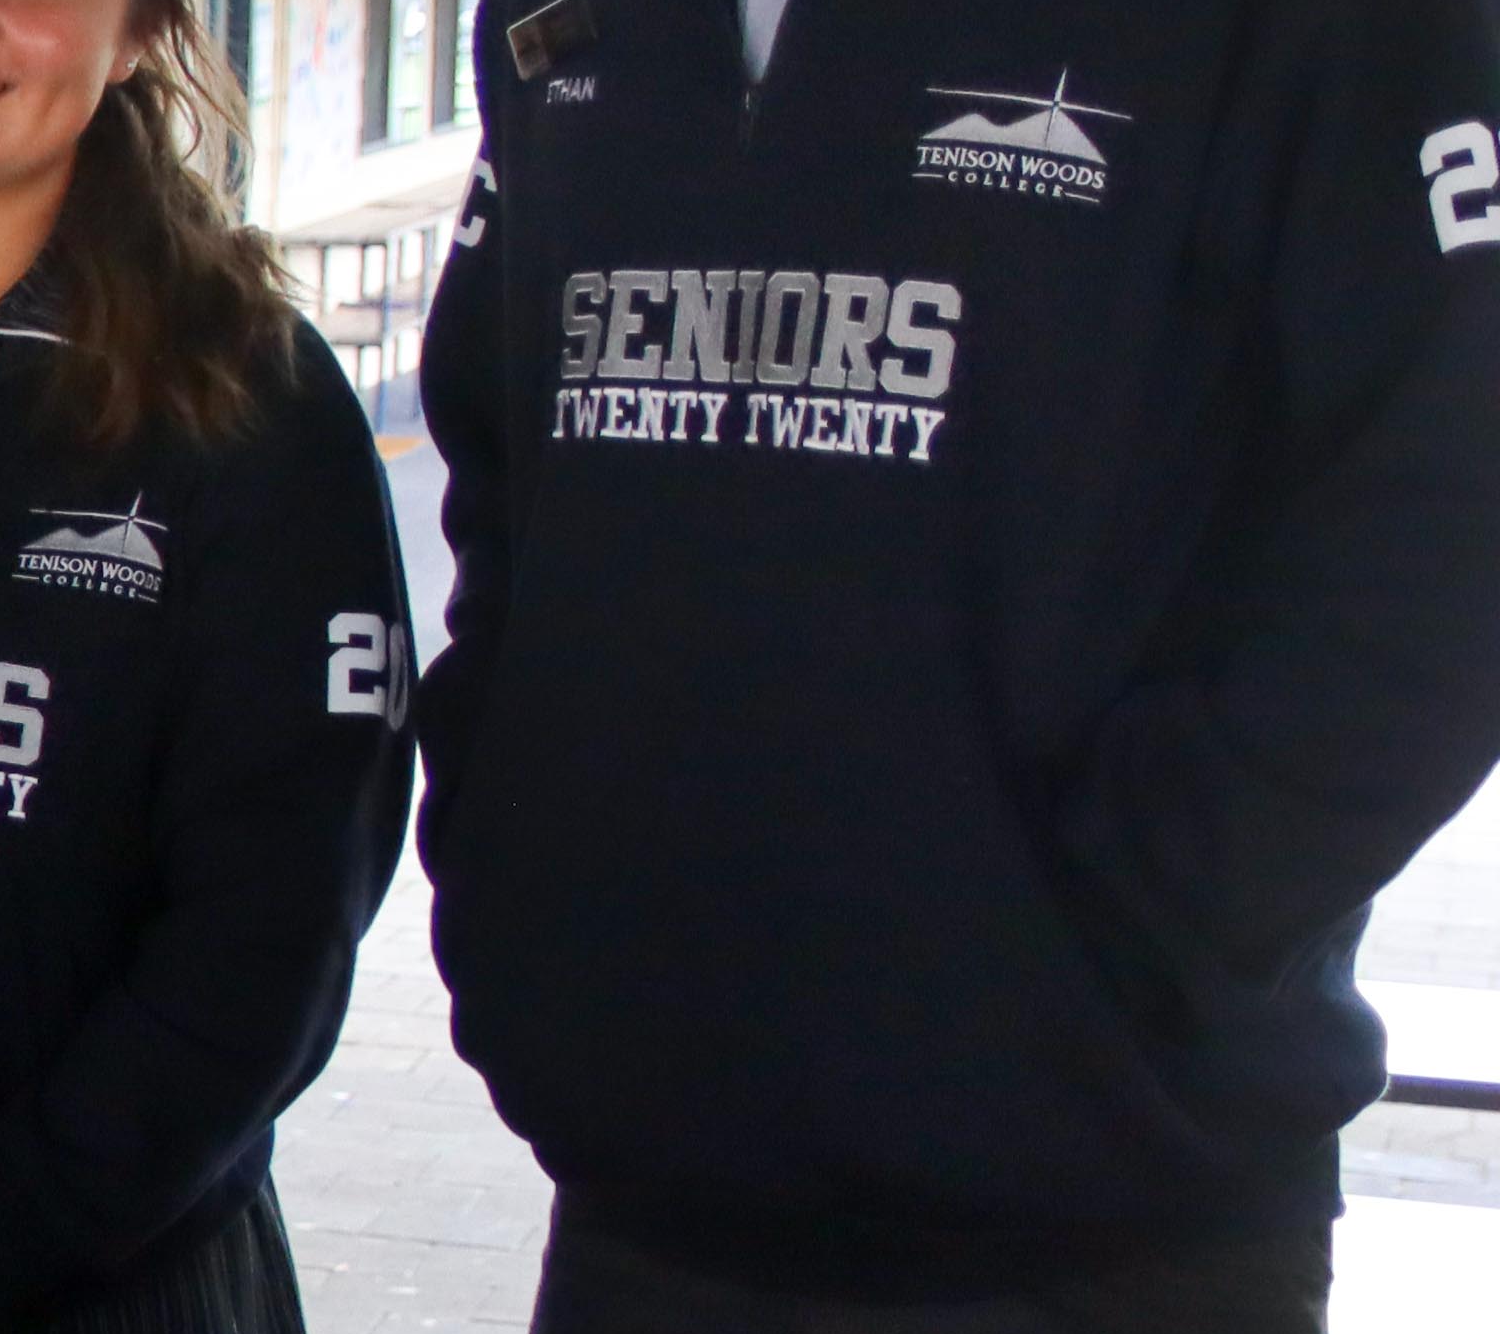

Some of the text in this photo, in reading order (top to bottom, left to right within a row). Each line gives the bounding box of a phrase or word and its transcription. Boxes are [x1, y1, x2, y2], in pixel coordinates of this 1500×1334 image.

[917, 146, 1107, 189] TENISON WOODS
[947, 171, 1063, 197] COLLEGE
[561, 269, 962, 398] SENIORS
[552, 387, 946, 461] TWENTY TWENTY
[18, 554, 162, 592] TENISON WOODS
[43, 574, 136, 598] COLLEGE
